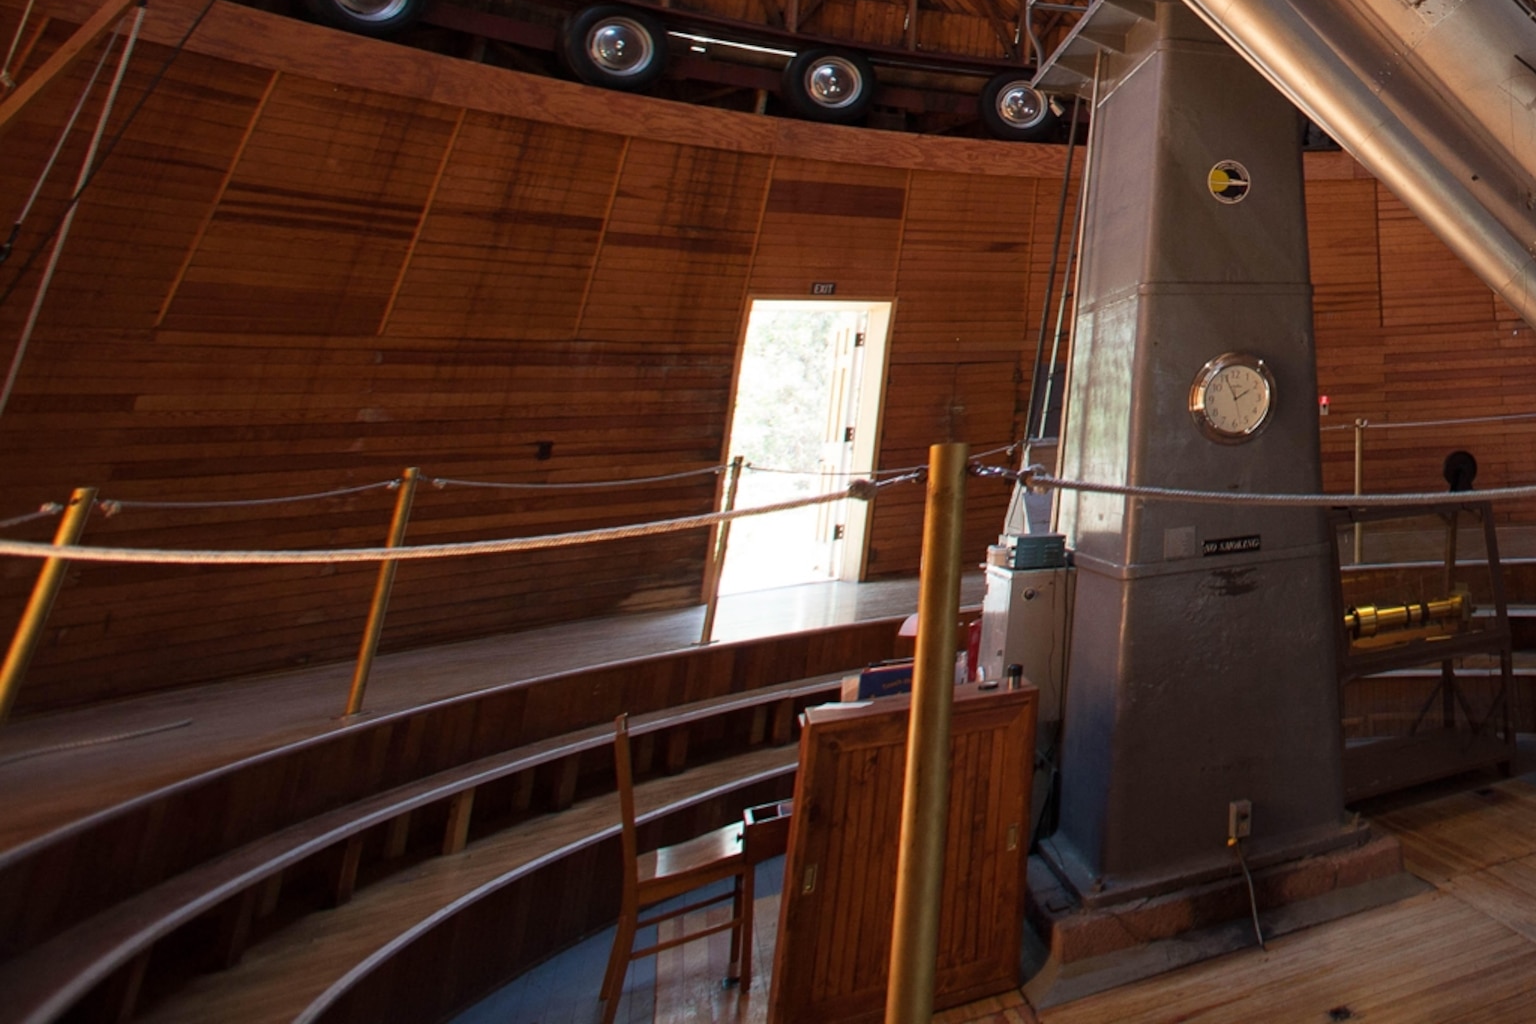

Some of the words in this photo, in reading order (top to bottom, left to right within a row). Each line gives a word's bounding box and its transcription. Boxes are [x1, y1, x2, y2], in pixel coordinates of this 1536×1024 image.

[814, 283, 834, 294] EXIT
[1203, 542, 1218, 553] NO
[1219, 538, 1260, 551] SMOKING
